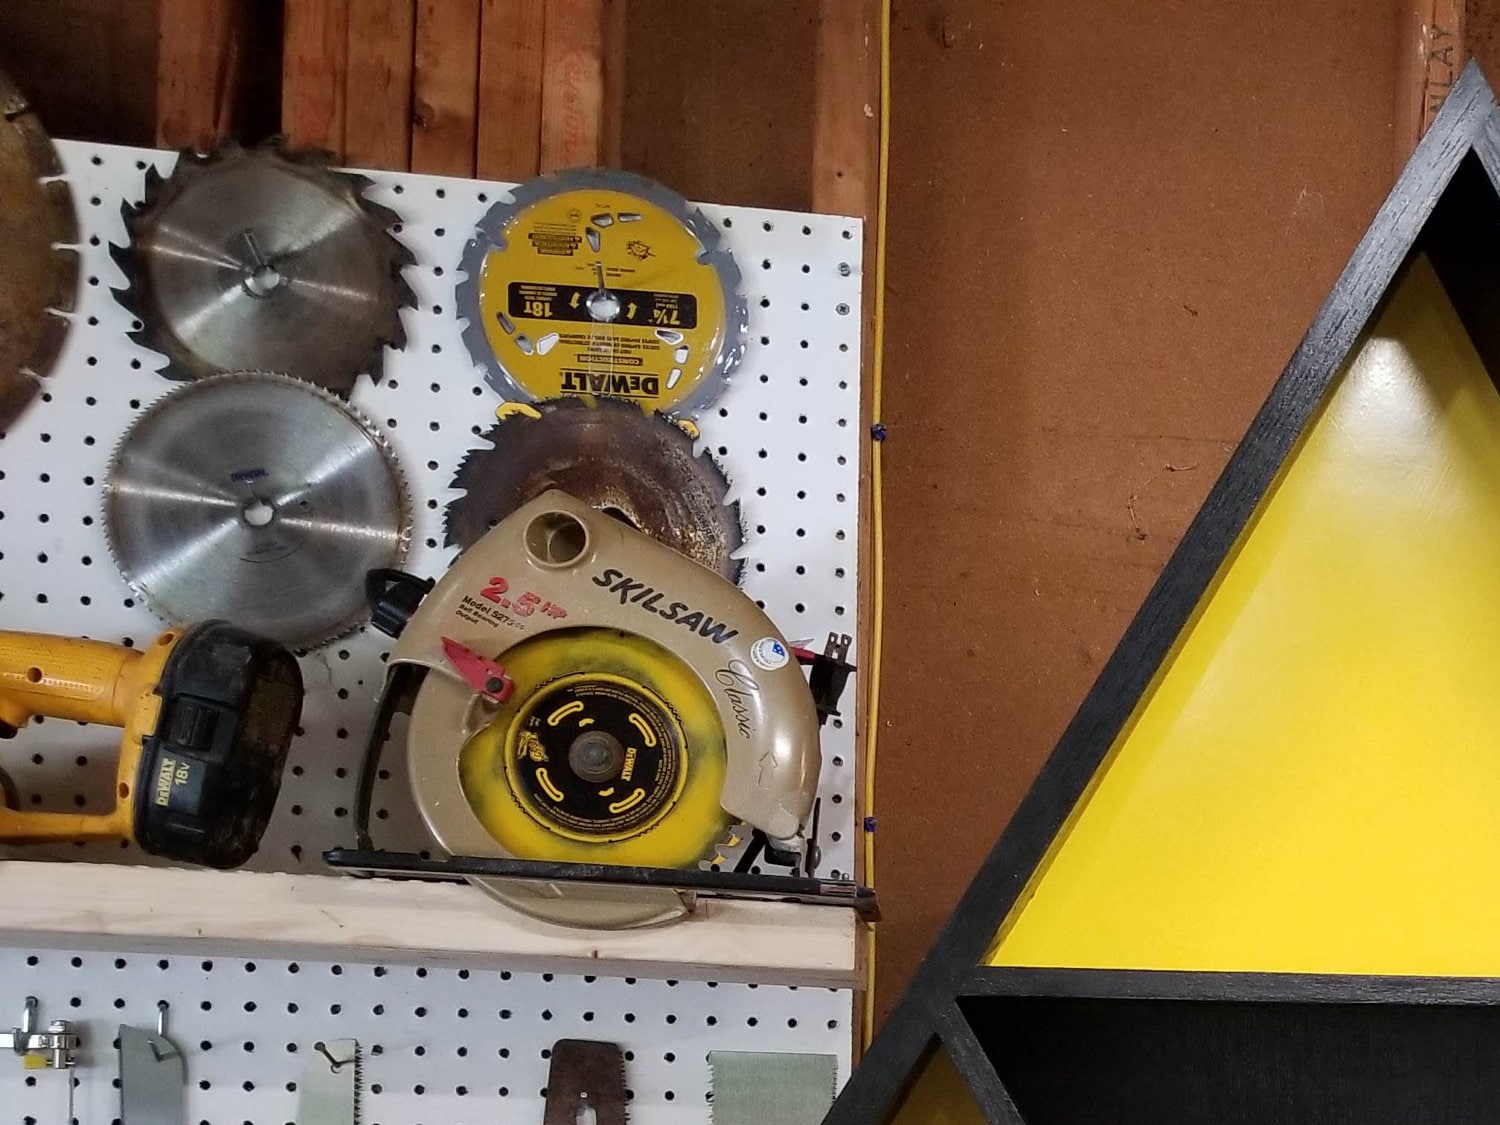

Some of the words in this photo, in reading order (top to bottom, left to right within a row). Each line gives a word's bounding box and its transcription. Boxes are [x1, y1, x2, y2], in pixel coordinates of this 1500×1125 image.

[524, 301, 553, 317] 18T
[579, 354, 640, 366] CONSTRUCTION
[462, 595, 492, 615] Model
[480, 576, 541, 617] 2.5
[592, 569, 738, 644] SKILSAW
[455, 610, 479, 625] Output
[714, 659, 760, 739] Classic
